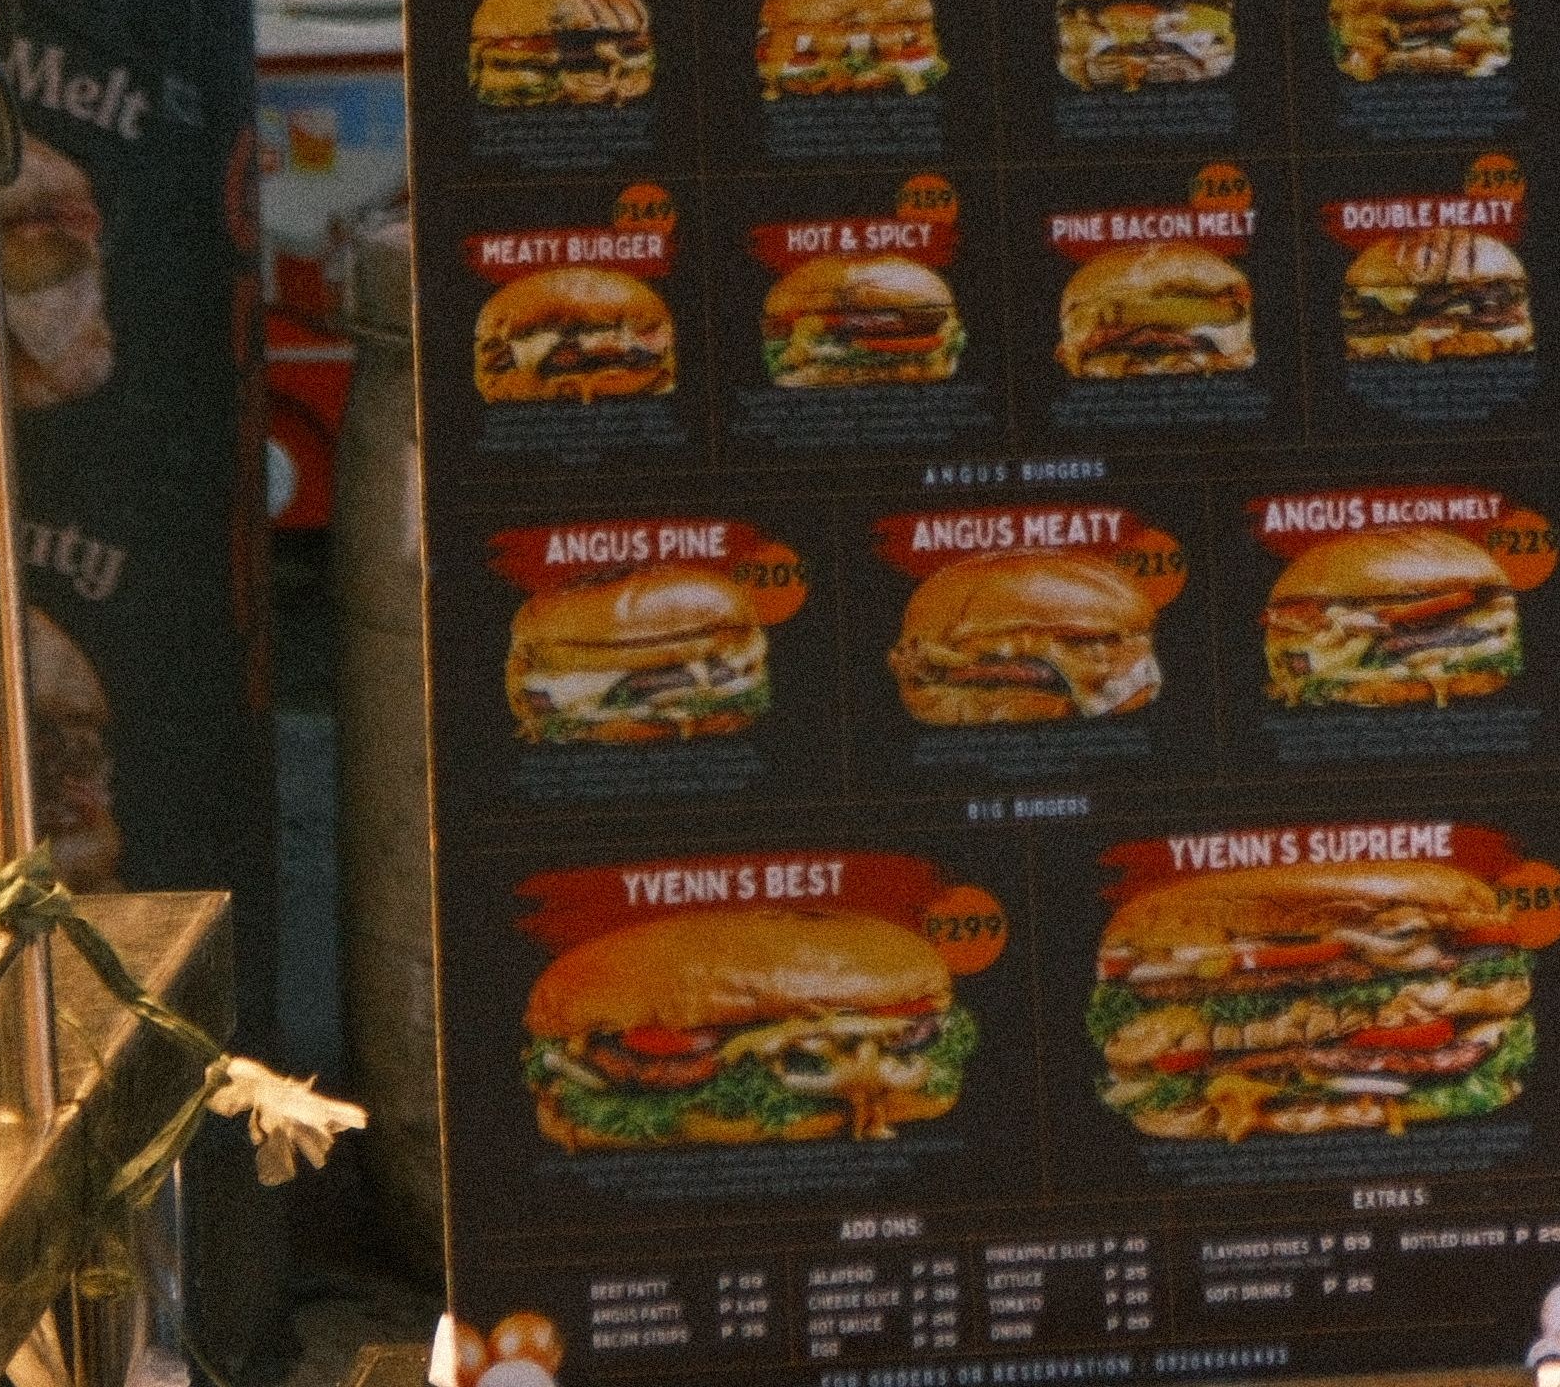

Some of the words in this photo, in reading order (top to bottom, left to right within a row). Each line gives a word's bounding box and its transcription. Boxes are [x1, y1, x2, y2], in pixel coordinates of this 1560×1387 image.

[1051, 213, 1105, 243] PINE
[1111, 211, 1191, 241] BACON
[1197, 208, 1257, 238] MELT
[1340, 202, 1430, 231] DOUBLE
[1438, 199, 1515, 227] MEATY
[481, 236, 560, 265] MEATY
[566, 232, 663, 262] BURGER
[786, 225, 833, 253] HOT
[840, 223, 859, 252] &
[865, 221, 933, 250] SPICY
[924, 465, 1005, 486] ANGUS
[1021, 460, 1106, 482] BURGERS
[1263, 498, 1366, 534] ANGUS
[1371, 498, 1443, 526] BACON
[1447, 495, 1502, 522] MELT
[545, 529, 650, 566] ANGUS
[658, 523, 729, 560] PINE
[911, 516, 1015, 553] ANGUS
[1022, 511, 1124, 546] MEATY
[966, 801, 1004, 821] BIG
[1014, 797, 1089, 819] BURGERS
[1167, 833, 1299, 871] YVENN'S
[1307, 822, 1455, 865] SUPREME
[621, 867, 757, 906] YVENN'S
[764, 861, 844, 898] BEST
[840, 1218, 877, 1240] ADD
